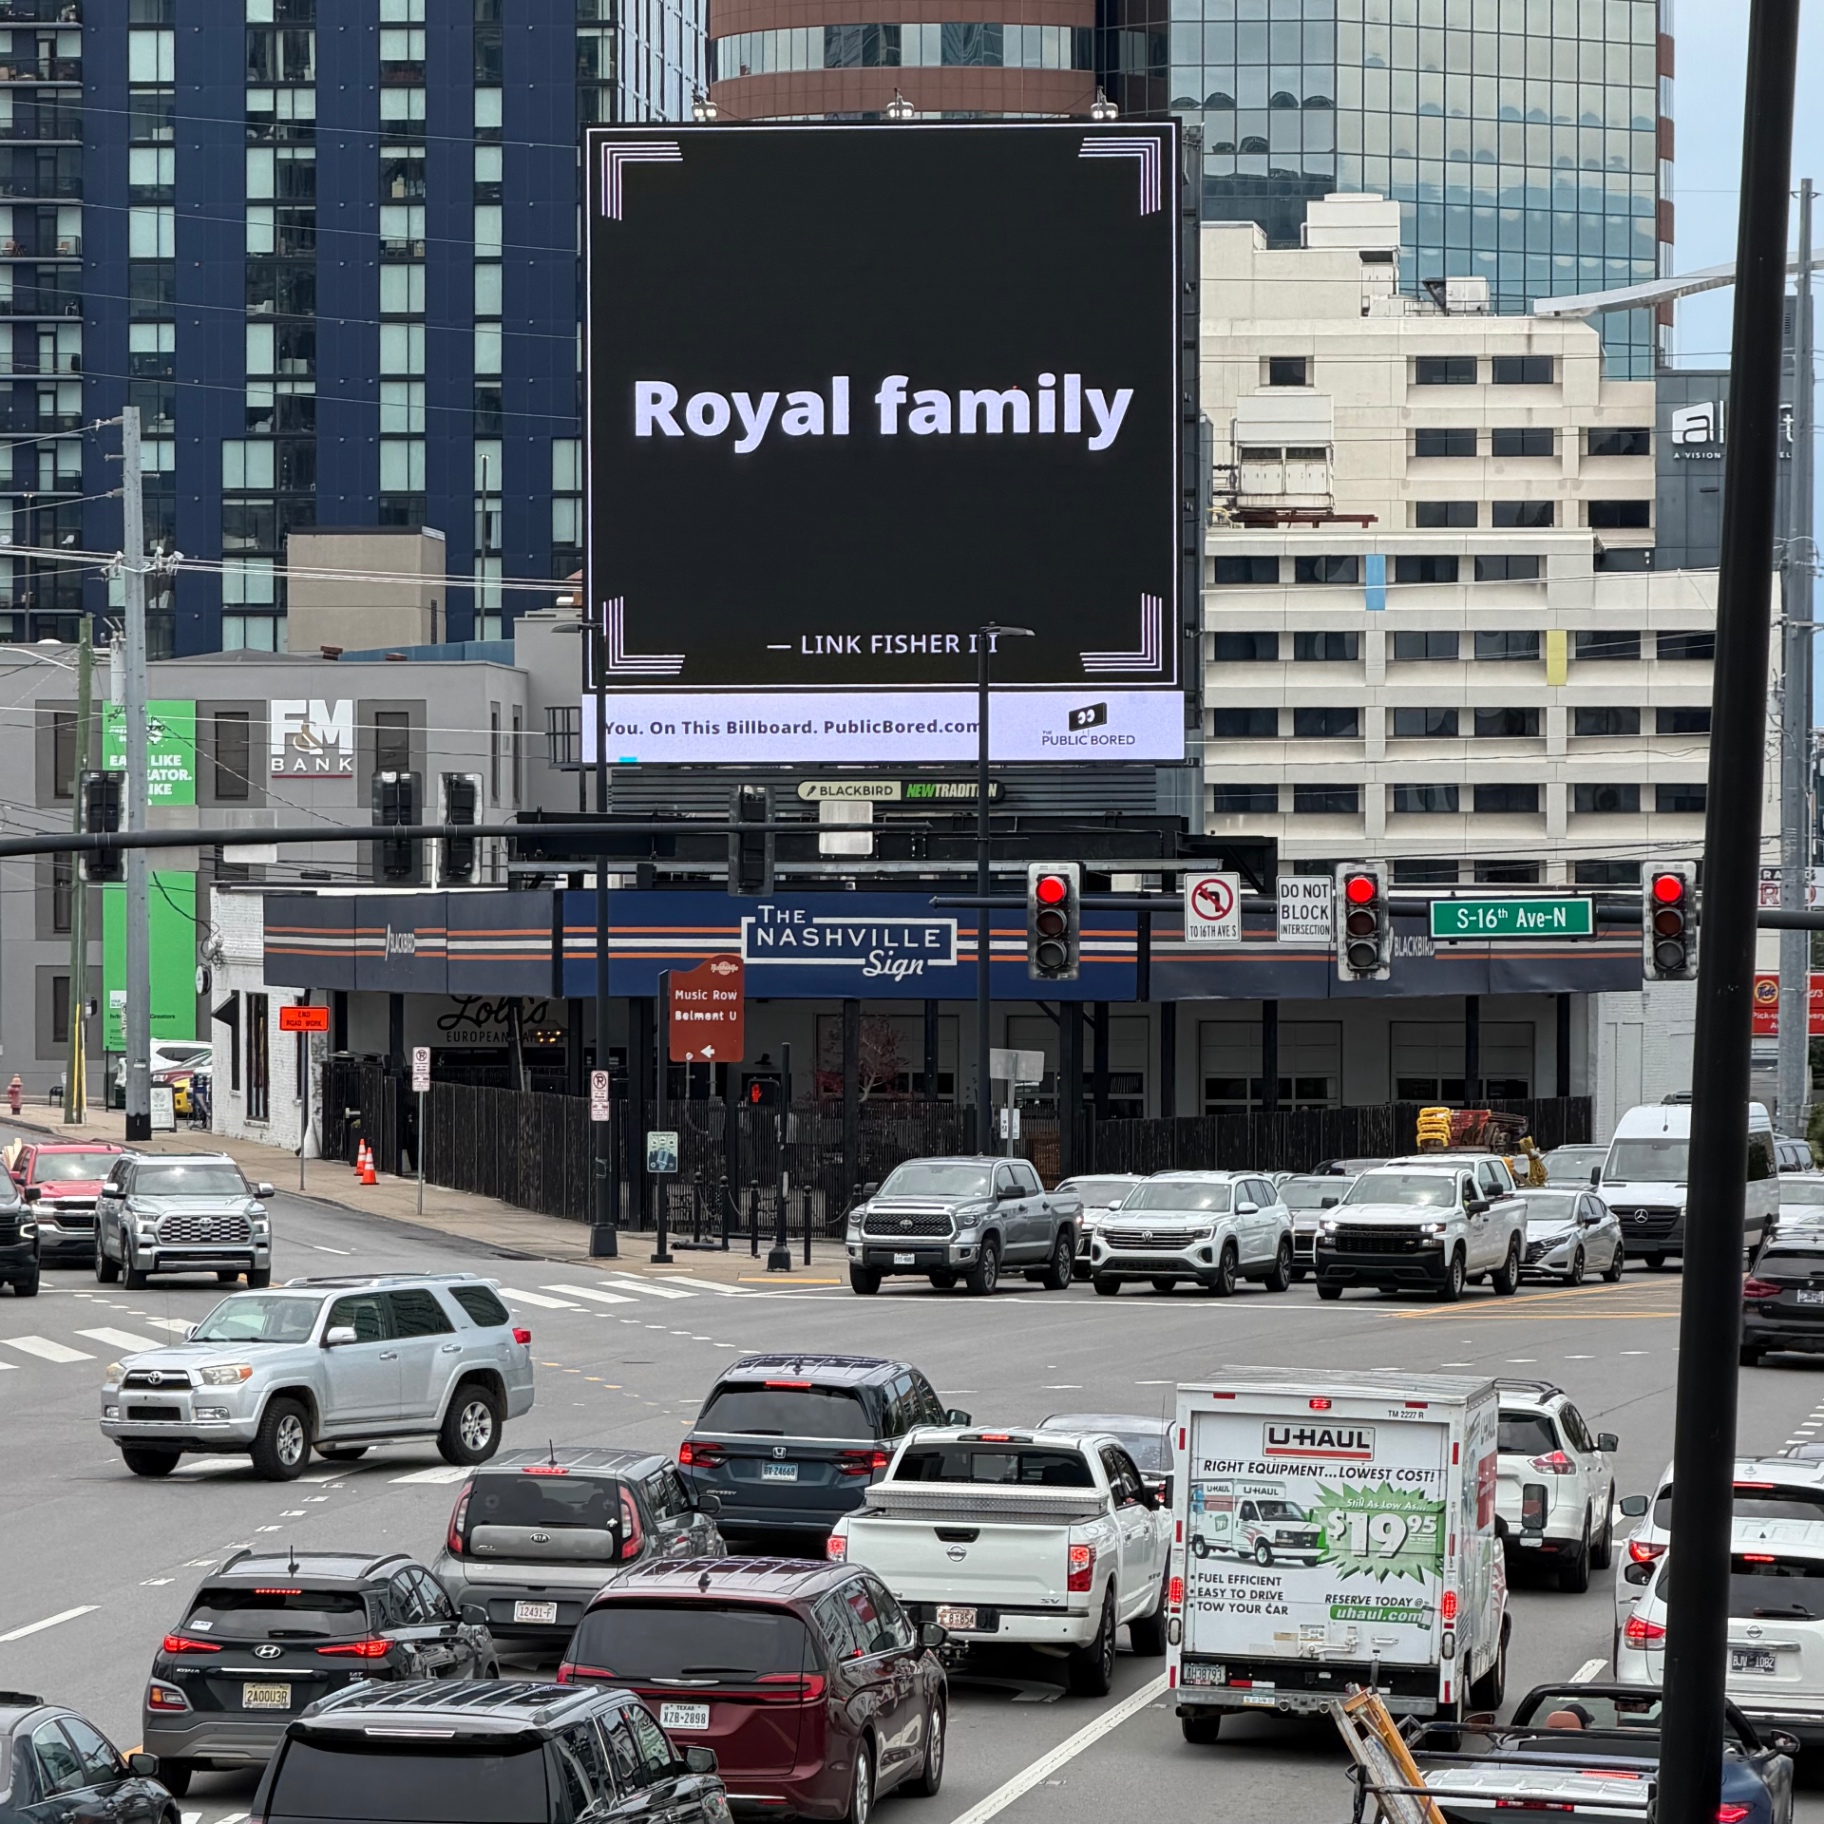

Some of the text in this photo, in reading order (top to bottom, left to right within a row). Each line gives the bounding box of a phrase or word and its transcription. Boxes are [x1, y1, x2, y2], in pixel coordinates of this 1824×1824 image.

[635, 372, 1134, 454] Royal family
[801, 634, 861, 654] LINK
[871, 634, 961, 653] FISHER
[969, 634, 997, 653] II
[271, 700, 353, 754] F&M
[605, 719, 980, 735] You. On This Billboard. PublicBored.com
[1042, 735, 1135, 746] PUBLIC BORED
[151, 755, 182, 766] LIKE
[271, 758, 353, 771] BANK
[148, 784, 172, 795] IKE
[820, 785, 893, 796] BLACKBIRD
[1281, 884, 1328, 898] DO NOT
[1281, 905, 1329, 919] BLOCK
[1516, 907, 1567, 928] Ave-N
[1190, 925, 1237, 938] TO 16TH AVE S
[1281, 924, 1330, 935] INTERSECTION
[757, 928, 940, 947] NASHVILLE
[862, 950, 923, 982] Sign
[675, 989, 737, 1000] Music Row
[729, 1011, 737, 1020] U
[447, 1031, 508, 1043] EUROPEAN
[1388, 1410, 1424, 1419] TM 2227 R
[1269, 1427, 1370, 1449] U-HAUL
[1203, 1460, 1244, 1473] RIGHT
[1396, 1469, 1435, 1482] COST!
[1206, 1485, 1230, 1493] U-HAUL
[1243, 1486, 1279, 1496] U-HAUL
[1347, 1497, 1364, 1508] Still
[1366, 1499, 1378, 1508] As
[1382, 1500, 1401, 1510] Low
[1198, 1573, 1282, 1586] FUEL EFFICIENT
[1197, 1587, 1284, 1601] EASY TO DRIVE
[1324, 1594, 1371, 1605] RESERVE
[1375, 1596, 1413, 1606] TODAY
[1197, 1601, 1288, 1615] TOW YOUR CAR
[1336, 1608, 1423, 1622] uhaul.com
